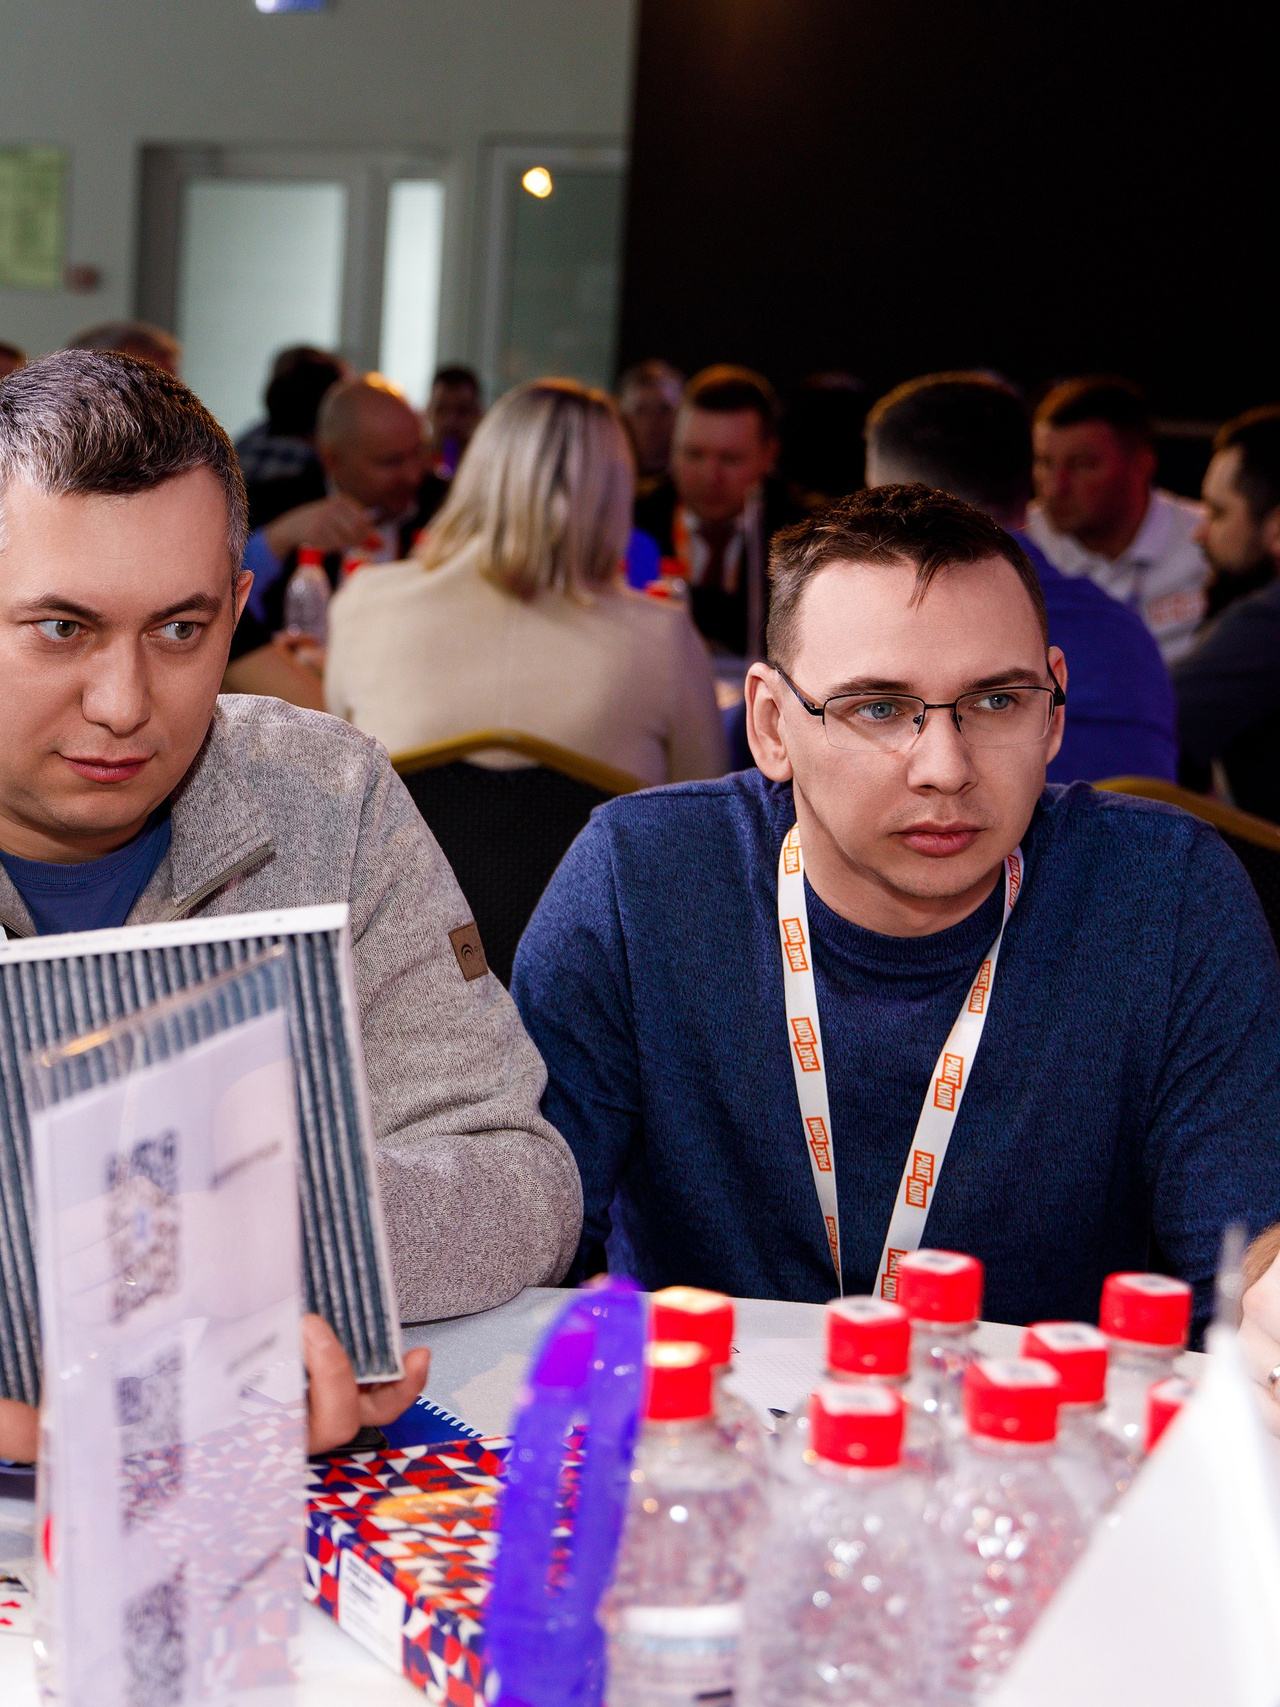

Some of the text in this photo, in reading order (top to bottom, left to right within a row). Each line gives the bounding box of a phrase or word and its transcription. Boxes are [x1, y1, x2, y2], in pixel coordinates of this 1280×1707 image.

[784, 847, 799, 872] PART
[783, 920, 808, 970] PART KOM
[969, 961, 990, 1012] PART KOM
[792, 1019, 819, 1070] PART KOM
[936, 1055, 962, 1109] PART KOM
[807, 1118, 831, 1169] PART KOM
[907, 1152, 933, 1207] PART KOM
